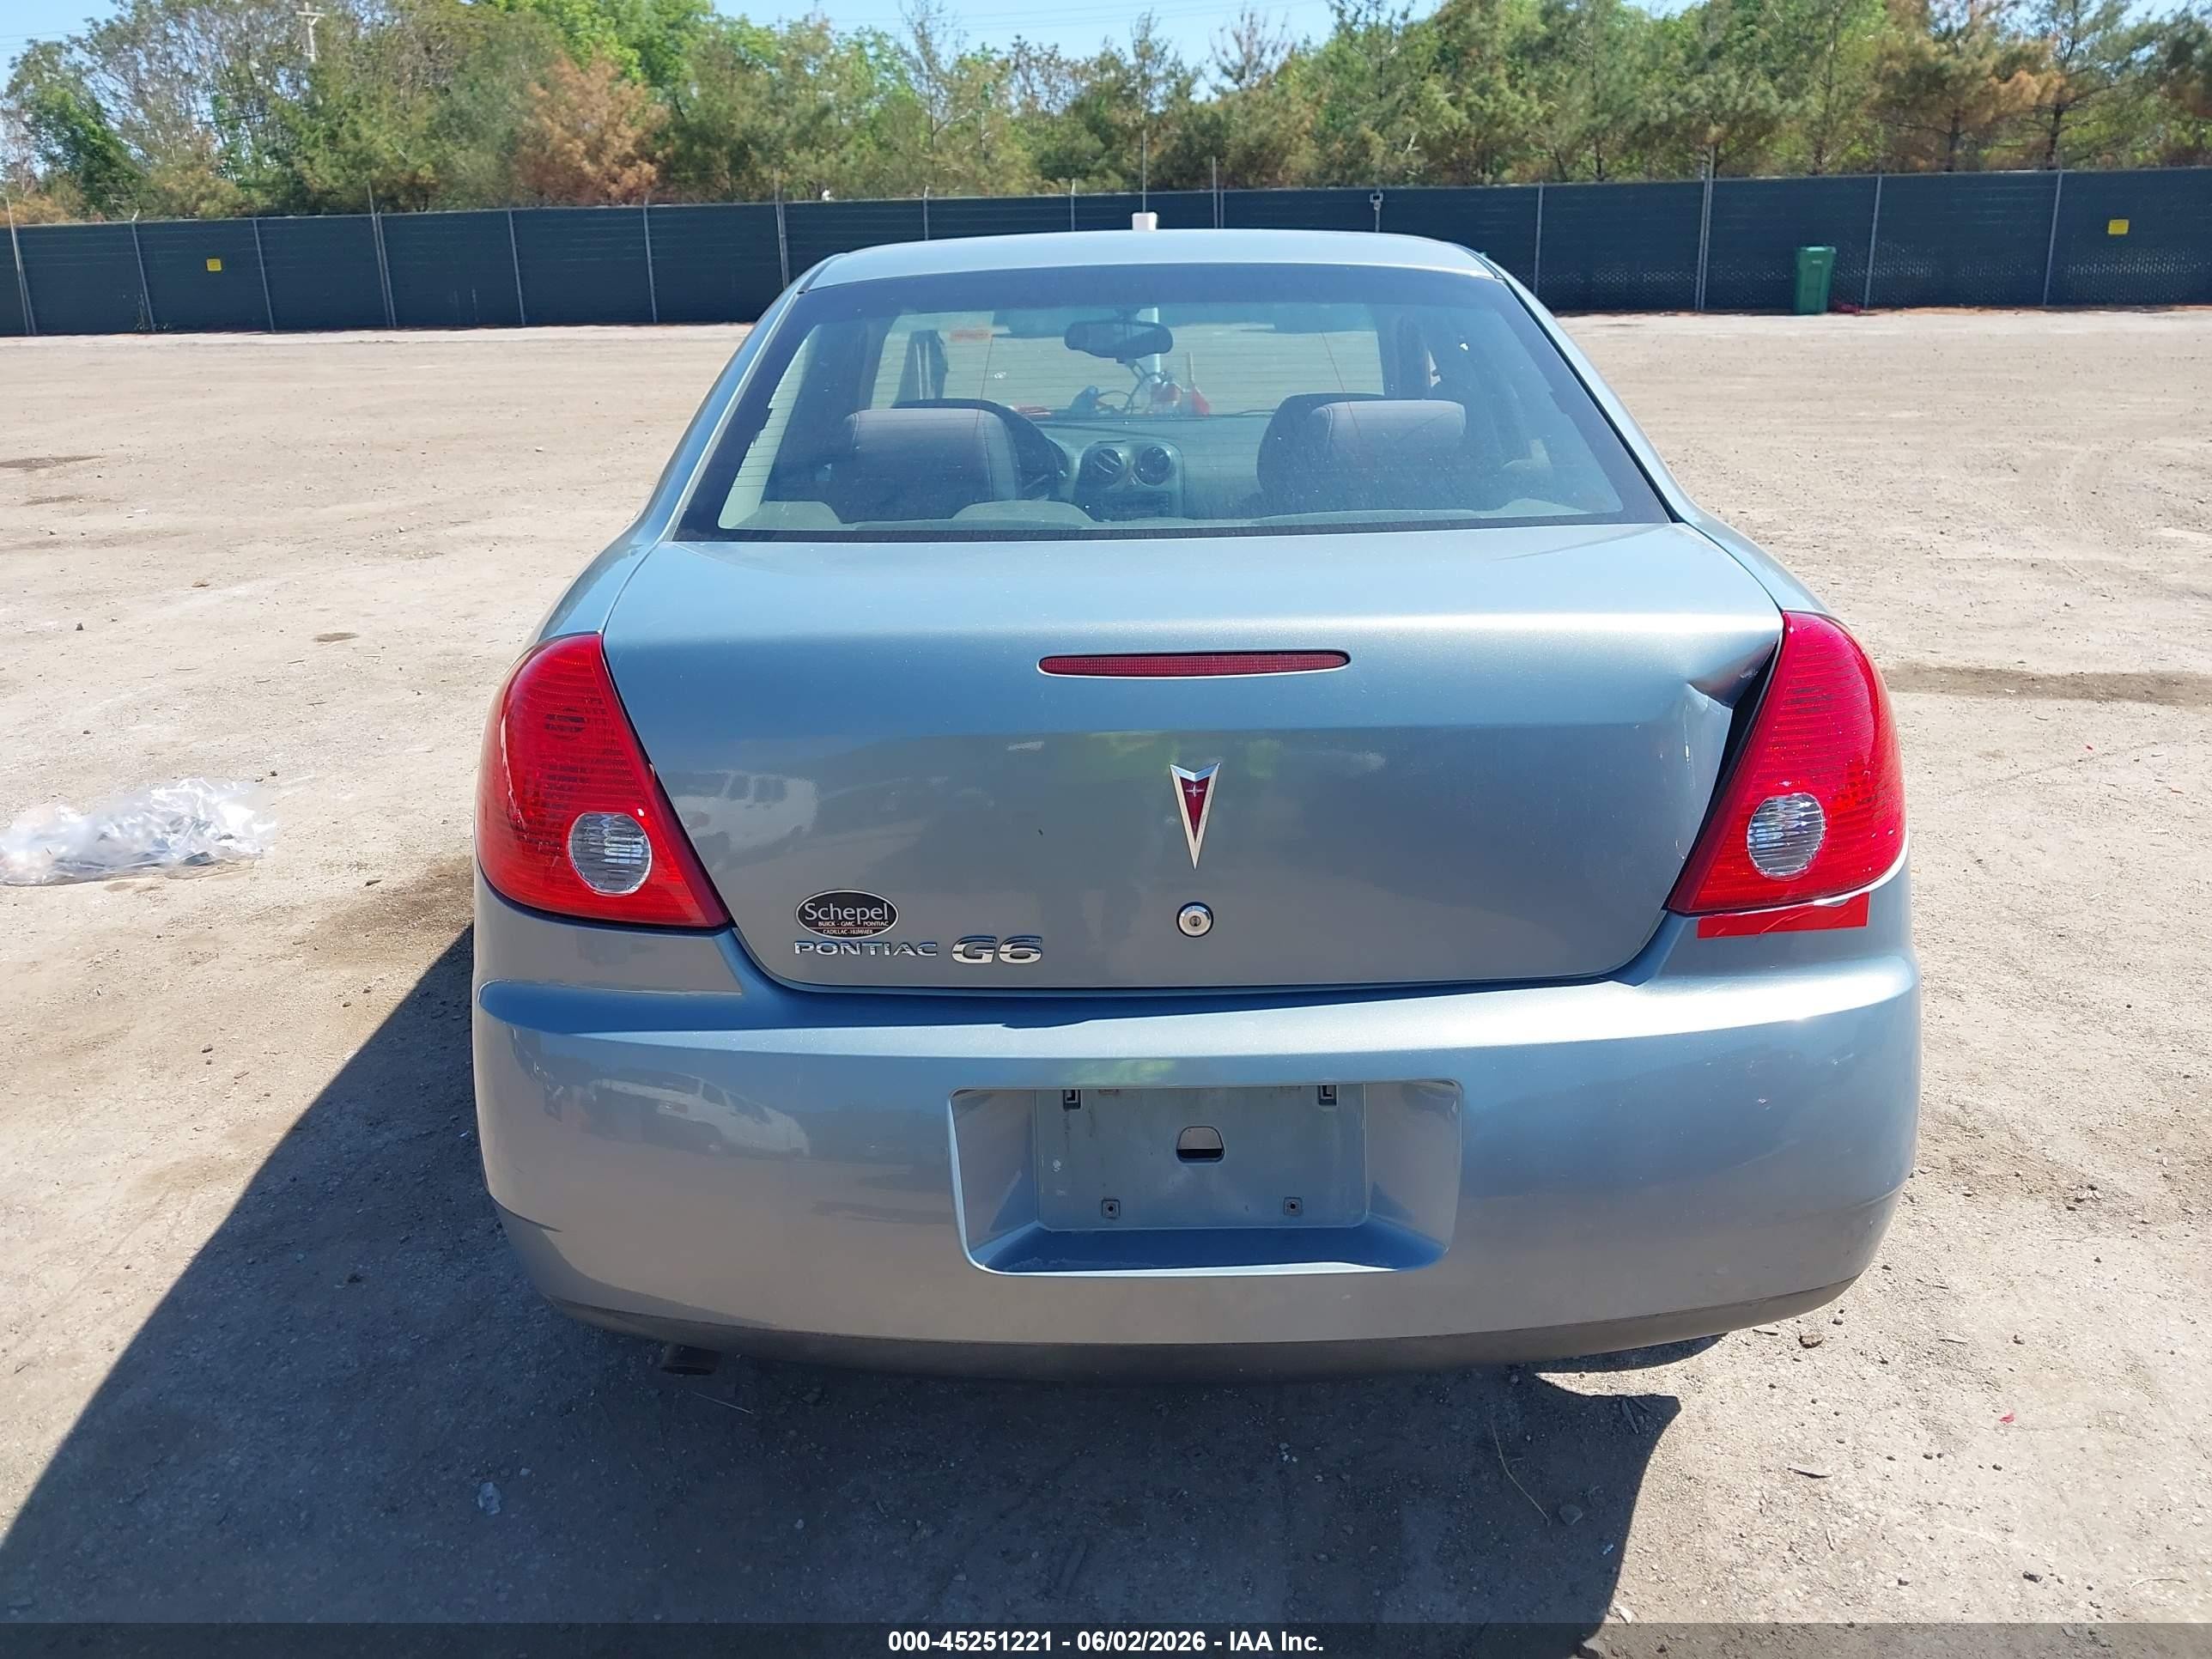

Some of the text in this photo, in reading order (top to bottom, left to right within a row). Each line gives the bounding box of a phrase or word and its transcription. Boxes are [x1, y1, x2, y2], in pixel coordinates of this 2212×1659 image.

[805, 902, 889, 925] Schepel
[793, 934, 1043, 963] PONTIAC G6
